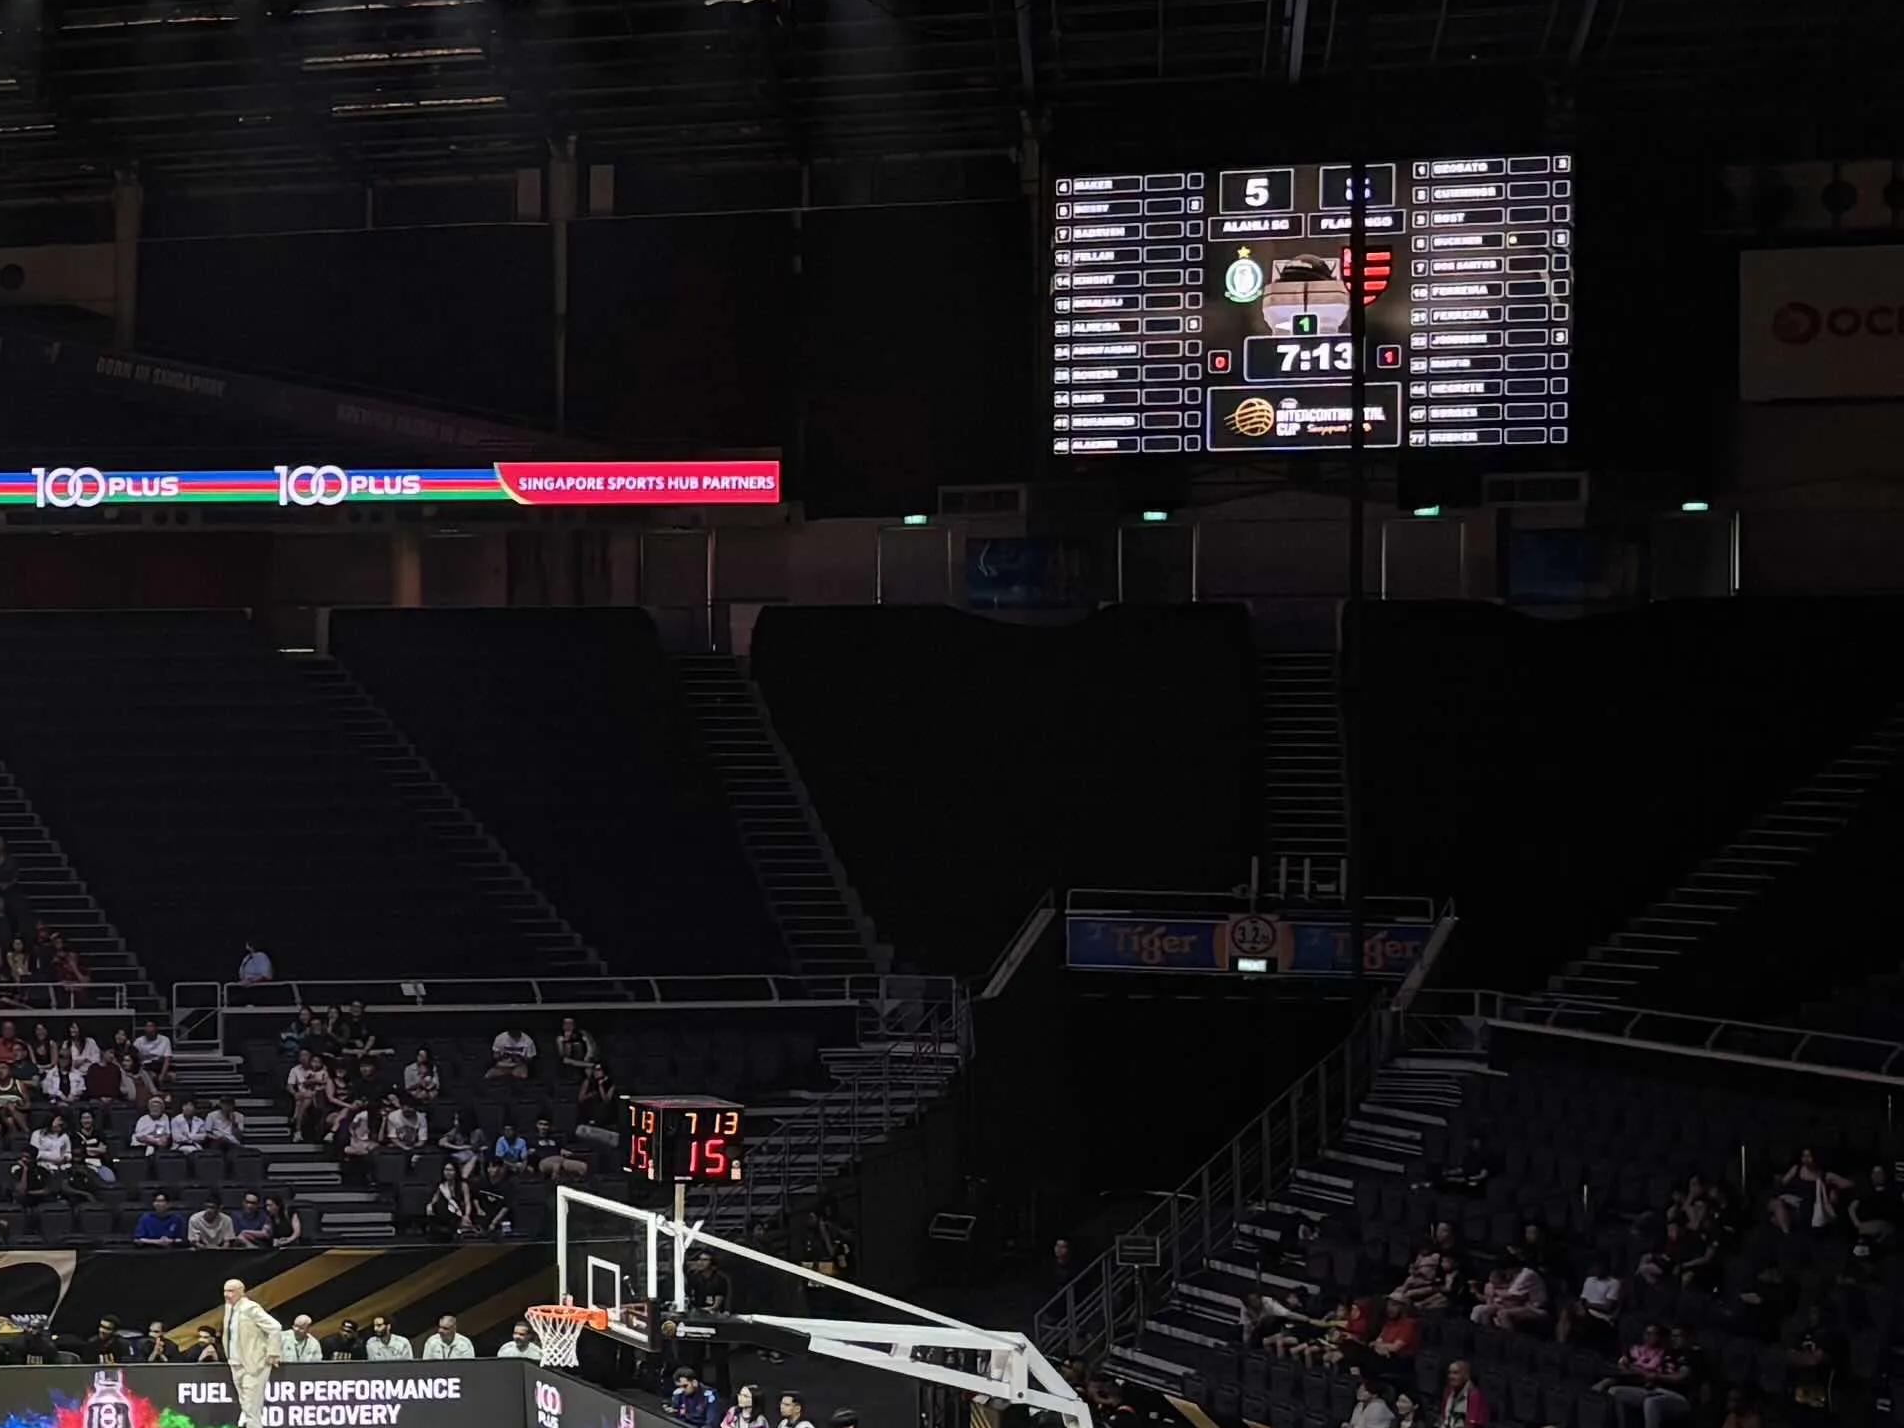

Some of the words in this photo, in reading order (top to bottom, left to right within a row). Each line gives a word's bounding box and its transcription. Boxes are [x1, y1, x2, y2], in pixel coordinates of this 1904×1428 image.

[1245, 178, 1269, 207] 5
[1299, 317, 1311, 332] 1
[1827, 305, 1904, 337] OC
[1276, 343, 1354, 372] 7:13
[519, 476, 604, 490] SINGAPORE
[607, 476, 664, 490] SPORTS
[668, 476, 699, 489] HUB
[702, 476, 775, 489] PARTNERS
[1112, 926, 1198, 964] Tiger
[1330, 929, 1419, 969] Tger
[689, 1139, 725, 1173] 15
[178, 1382, 232, 1404] FUEL
[300, 1378, 461, 1402] PERFORMANCE
[535, 1380, 561, 1415] 100
[289, 1404, 401, 1427] RECOVERY
